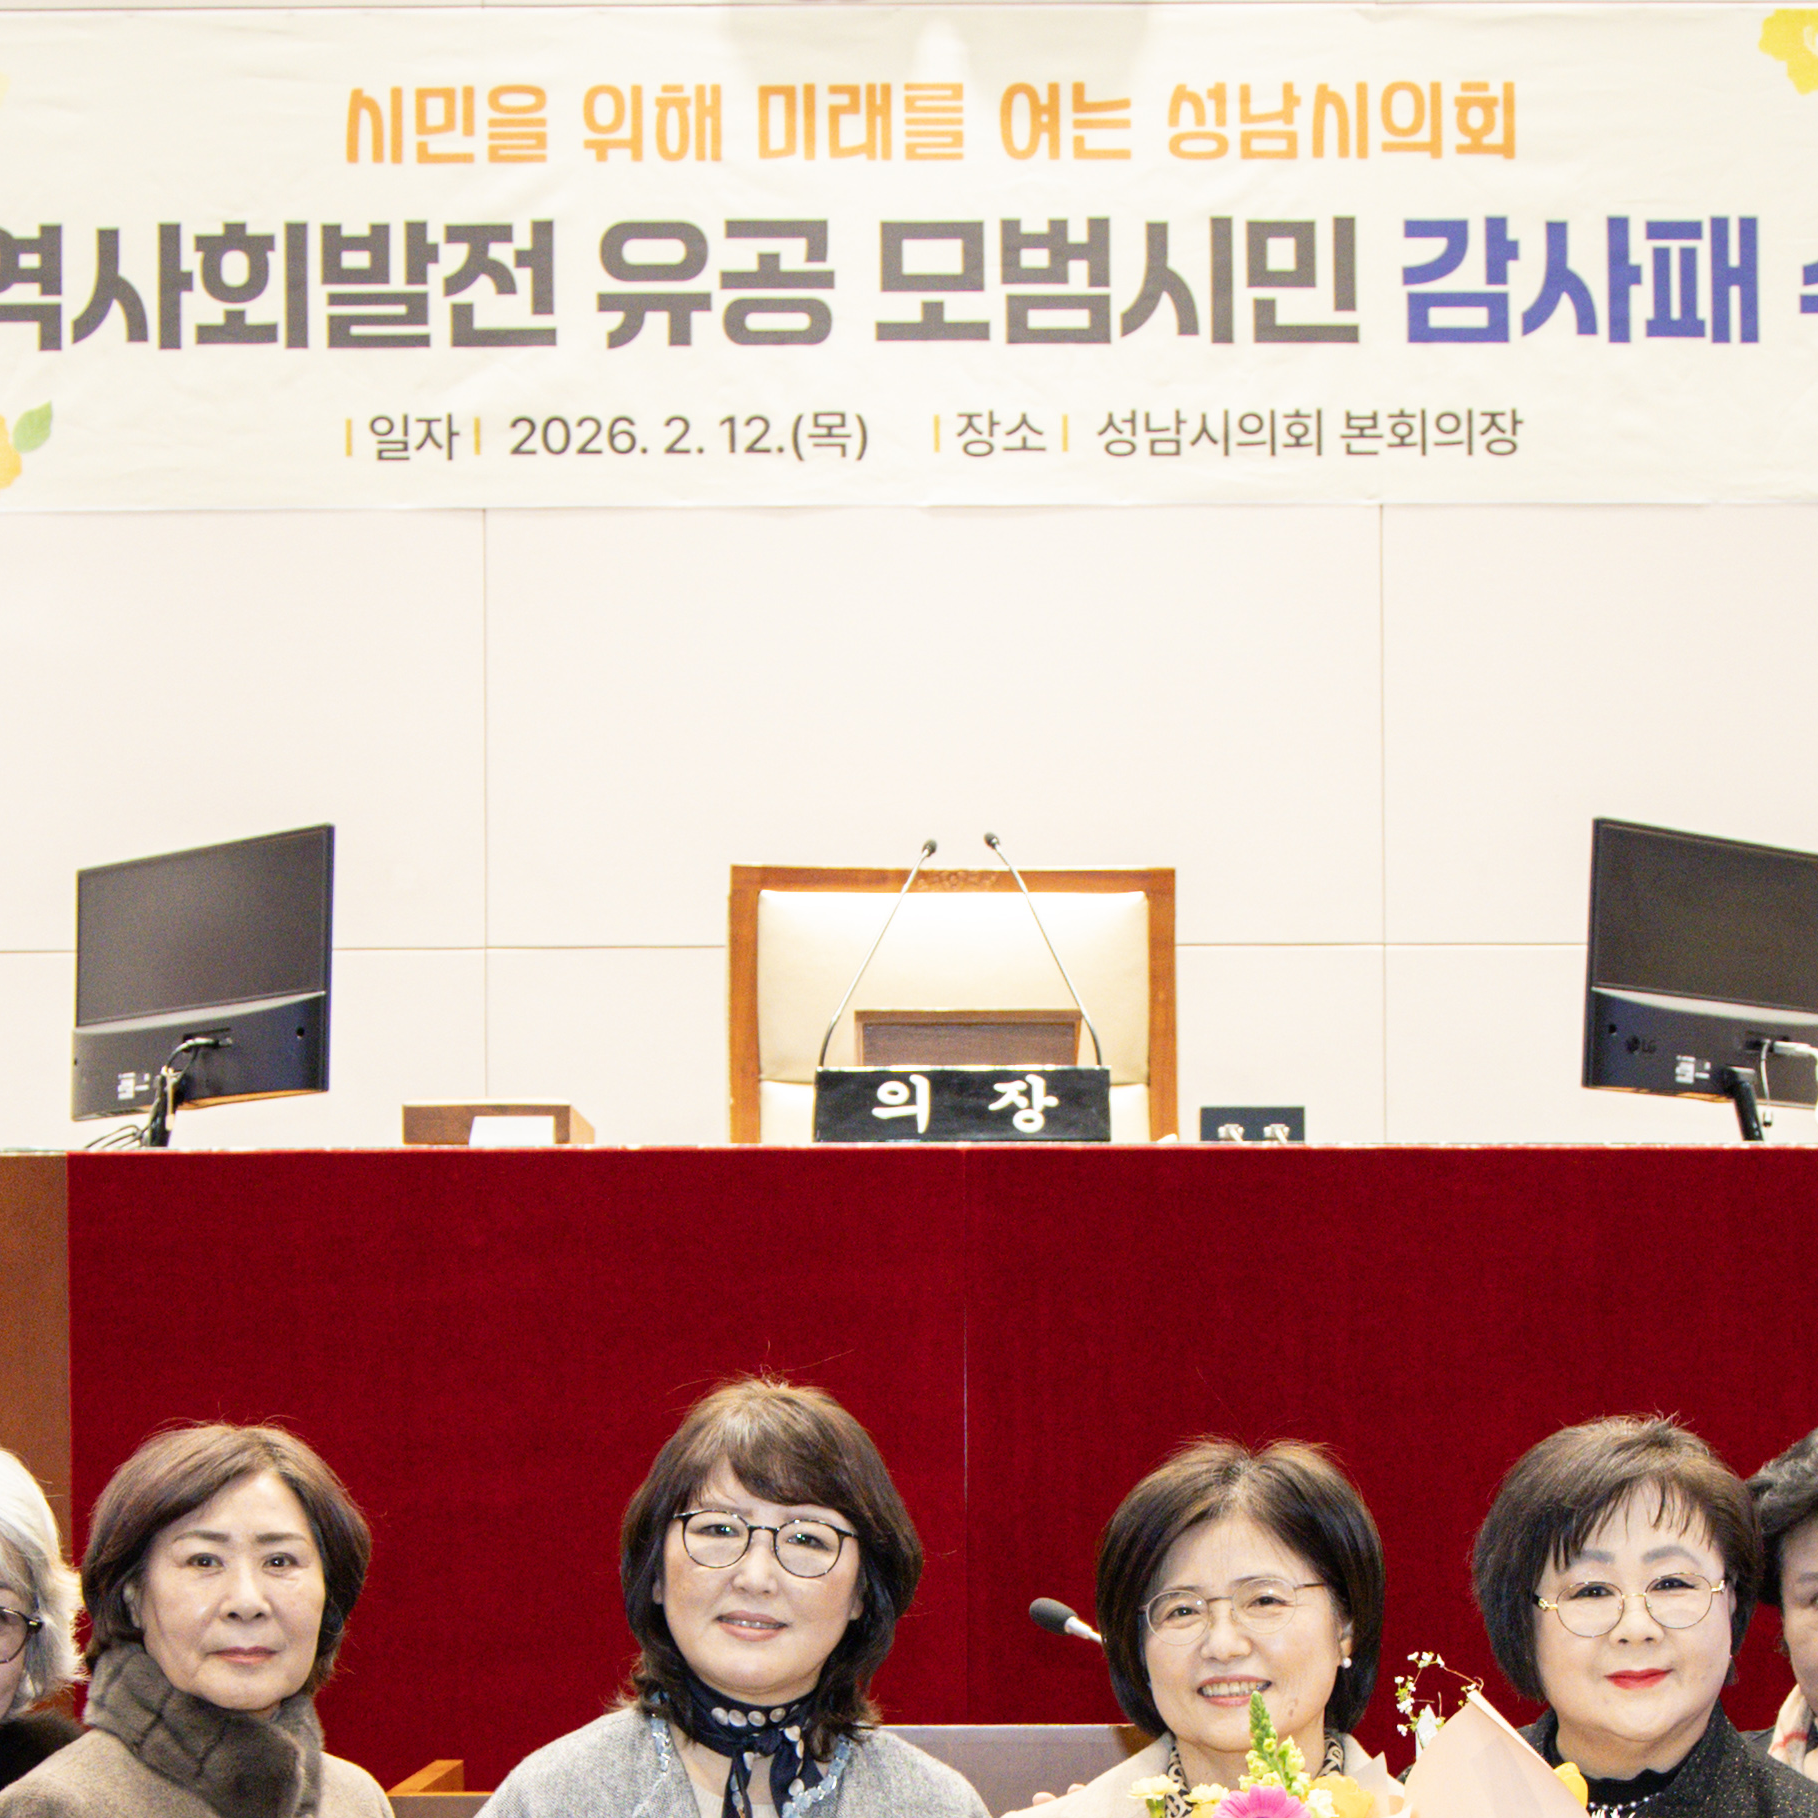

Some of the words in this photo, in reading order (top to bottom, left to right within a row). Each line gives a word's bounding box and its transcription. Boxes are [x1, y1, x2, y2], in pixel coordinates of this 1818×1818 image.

[345, 83, 548, 165] 시민을
[582, 83, 722, 163] 위해
[757, 81, 964, 161] 미래를
[999, 80, 1132, 160] 여는
[1167, 80, 1517, 161] 성남시의회
[595, 218, 836, 350] 유공
[874, 214, 1361, 346] 모범시민
[1401, 215, 1760, 345] 감사패
[368, 412, 461, 462] 일자
[508, 414, 649, 457] 2026.
[956, 409, 1047, 458] 장소
[1096, 408, 1323, 458] 성남시의회
[1339, 407, 1525, 457] 본회의장
